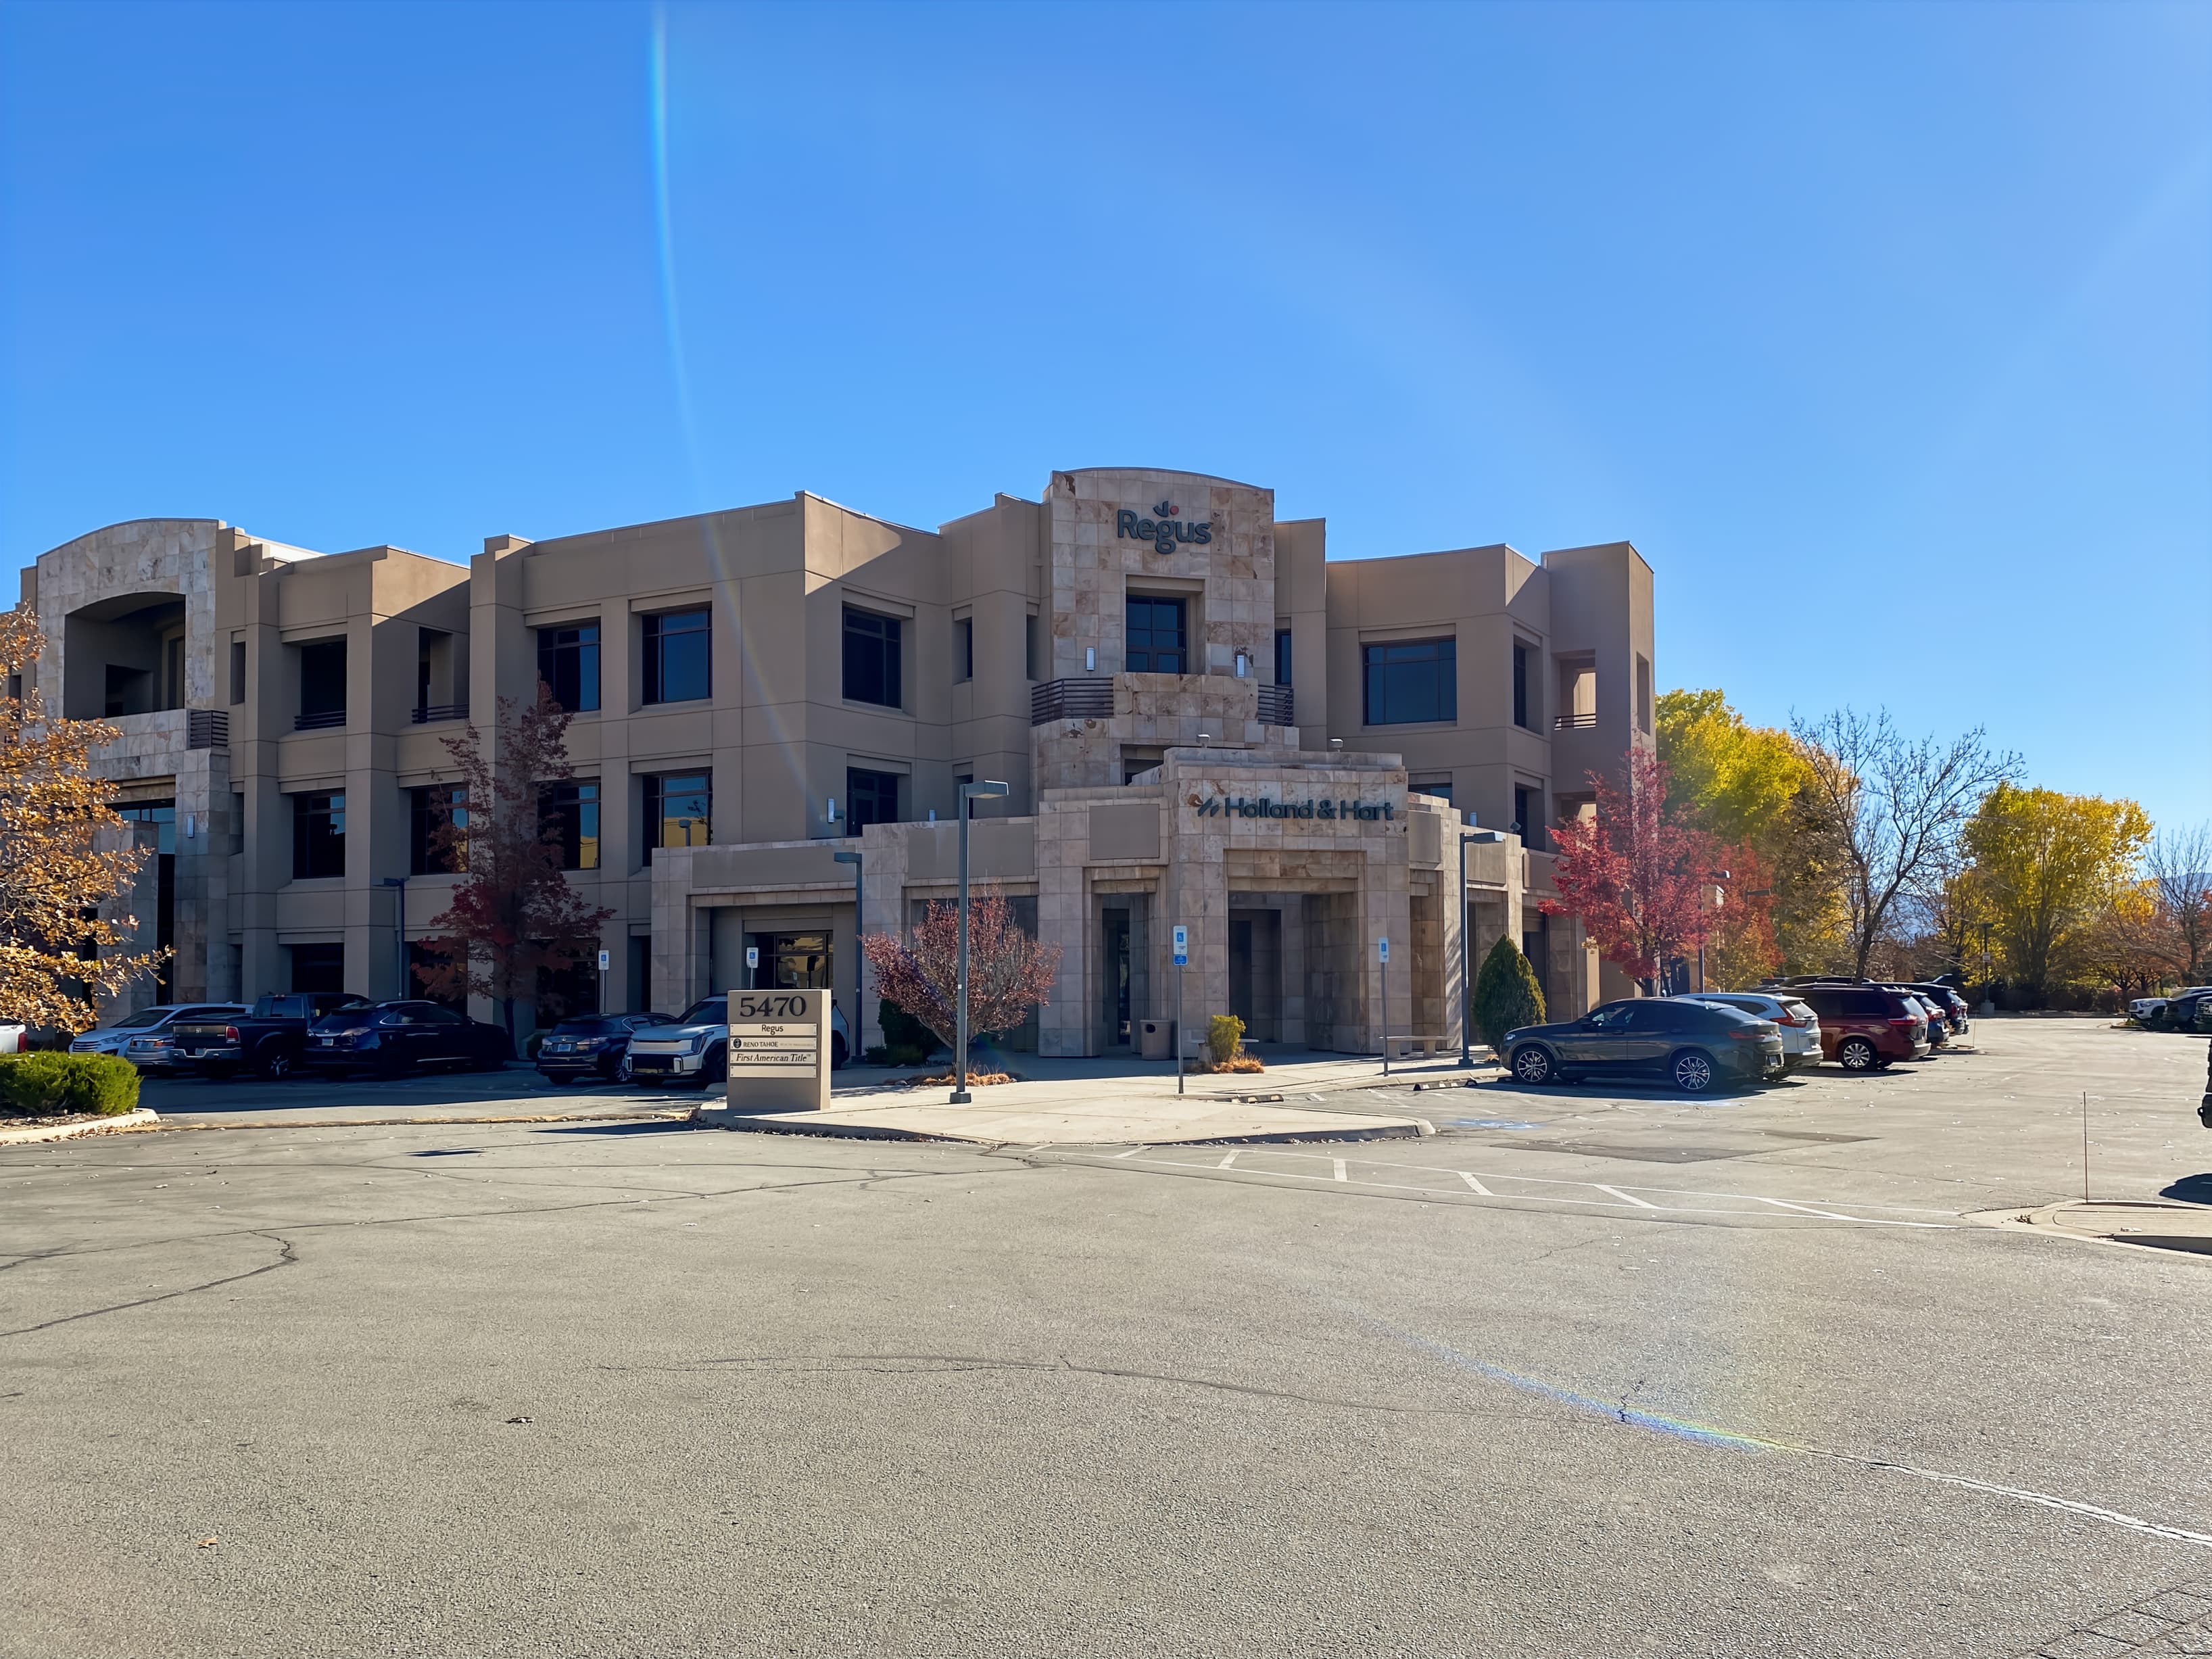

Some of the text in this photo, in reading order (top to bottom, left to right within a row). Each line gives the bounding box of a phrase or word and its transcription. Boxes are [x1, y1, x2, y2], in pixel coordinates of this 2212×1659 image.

[1117, 508, 1212, 555] Regus
[1224, 796, 1395, 821] Holland & Hart
[740, 995, 807, 1017] 5470
[761, 1024, 784, 1035] Regus
[736, 1053, 753, 1061] First
[754, 1053, 789, 1061] American
